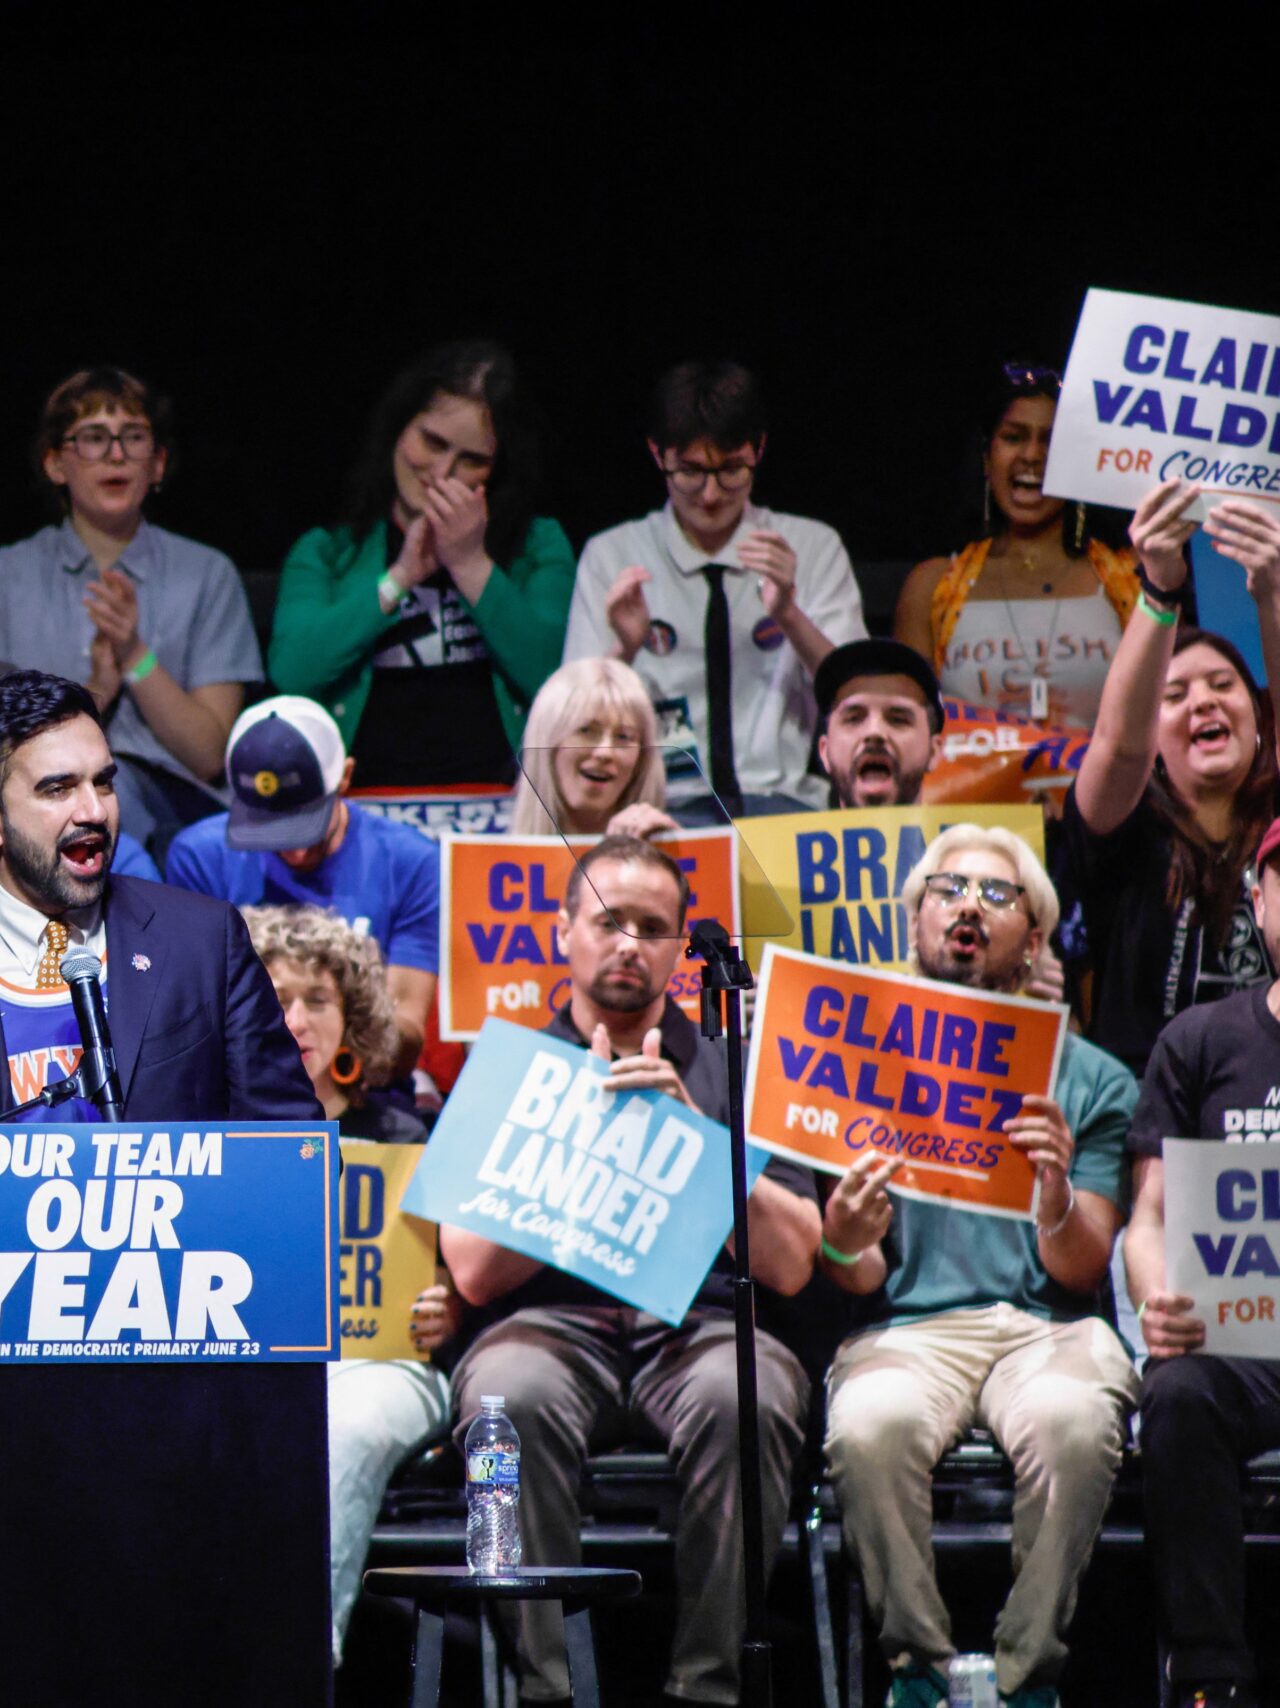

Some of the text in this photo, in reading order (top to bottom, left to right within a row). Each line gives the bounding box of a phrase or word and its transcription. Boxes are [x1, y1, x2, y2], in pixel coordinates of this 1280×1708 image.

[1093, 380, 1280, 454] VALD
[1096, 448, 1153, 474] FOR
[796, 824, 951, 904] BRA
[487, 980, 541, 1013] FOR
[803, 985, 1016, 1077] CLAIRE
[778, 1036, 1024, 1133] VALDEZ
[91, 1132, 223, 1177] TEAM
[506, 1050, 704, 1196] BRAD
[785, 1103, 1004, 1168] FOR CONGRESS
[26, 1178, 184, 1251] OUR
[477, 1121, 670, 1256] LANDER
[458, 1187, 636, 1276] for Congress
[1218, 1296, 1275, 1325] FOR
[15, 1343, 39, 1357] THE
[42, 1342, 130, 1357] DEMOCRATIC
[134, 1342, 199, 1356] PRIMARY
[202, 1342, 237, 1356] JUNE
[240, 1342, 260, 1356] 23
